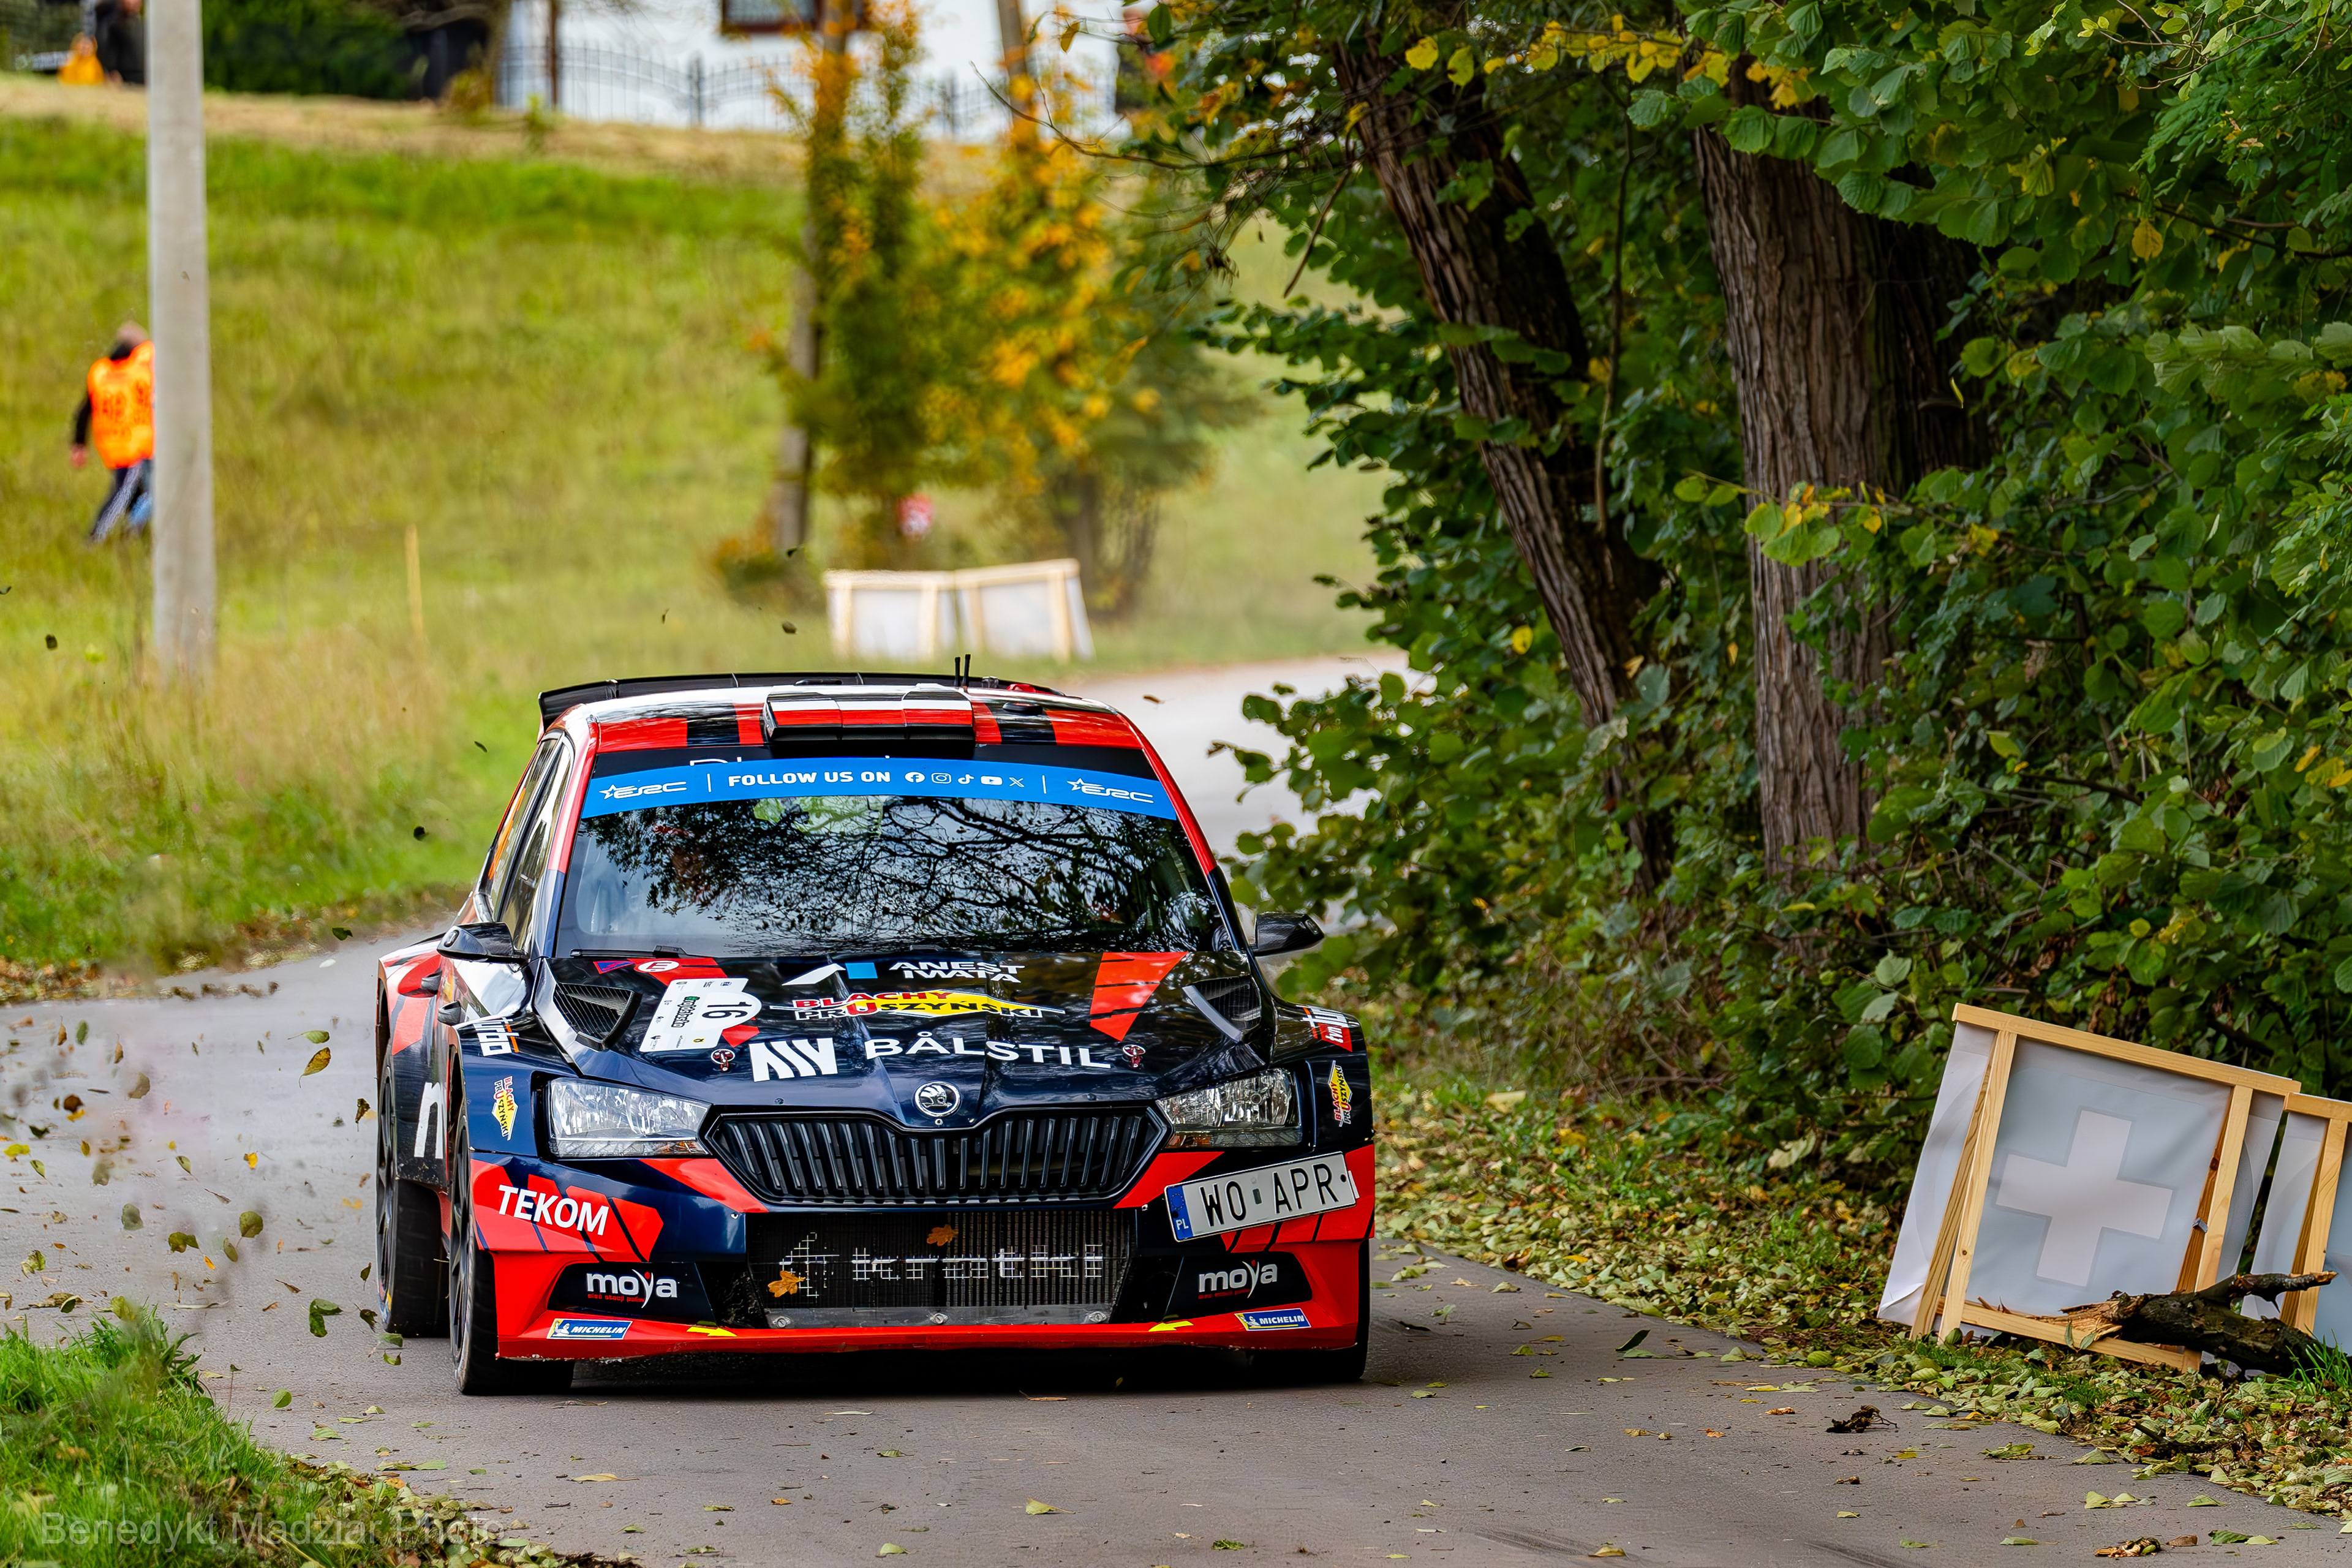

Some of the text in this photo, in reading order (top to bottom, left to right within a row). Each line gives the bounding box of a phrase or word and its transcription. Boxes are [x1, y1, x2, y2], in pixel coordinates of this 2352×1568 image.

[728, 771, 891, 787] FOLLOW US ON
[612, 782, 687, 799] ERC
[1081, 783, 1154, 804] ERC
[889, 961, 1025, 974] ANEST
[903, 970, 1022, 983] IWATA
[702, 1001, 752, 1019] 16
[794, 992, 953, 1008] BLACHY
[796, 1001, 1043, 1020] PRUSZYŃSKI
[865, 1031, 1111, 1069] BÅLSTIL
[503, 1076, 514, 1111] BLACHY
[1330, 1082, 1342, 1121] BLACHY
[1335, 1065, 1351, 1124] PRUSZYŃSKI
[494, 1080, 509, 1137] PRUSZYŃSKI
[1199, 1163, 1340, 1227] WO APR
[499, 1184, 609, 1236] TEKOM
[1175, 1219, 1189, 1231] PL
[586, 1269, 677, 1308] moya
[1199, 1261, 1278, 1298] moya
[1259, 1315, 1305, 1324] MICHELIN
